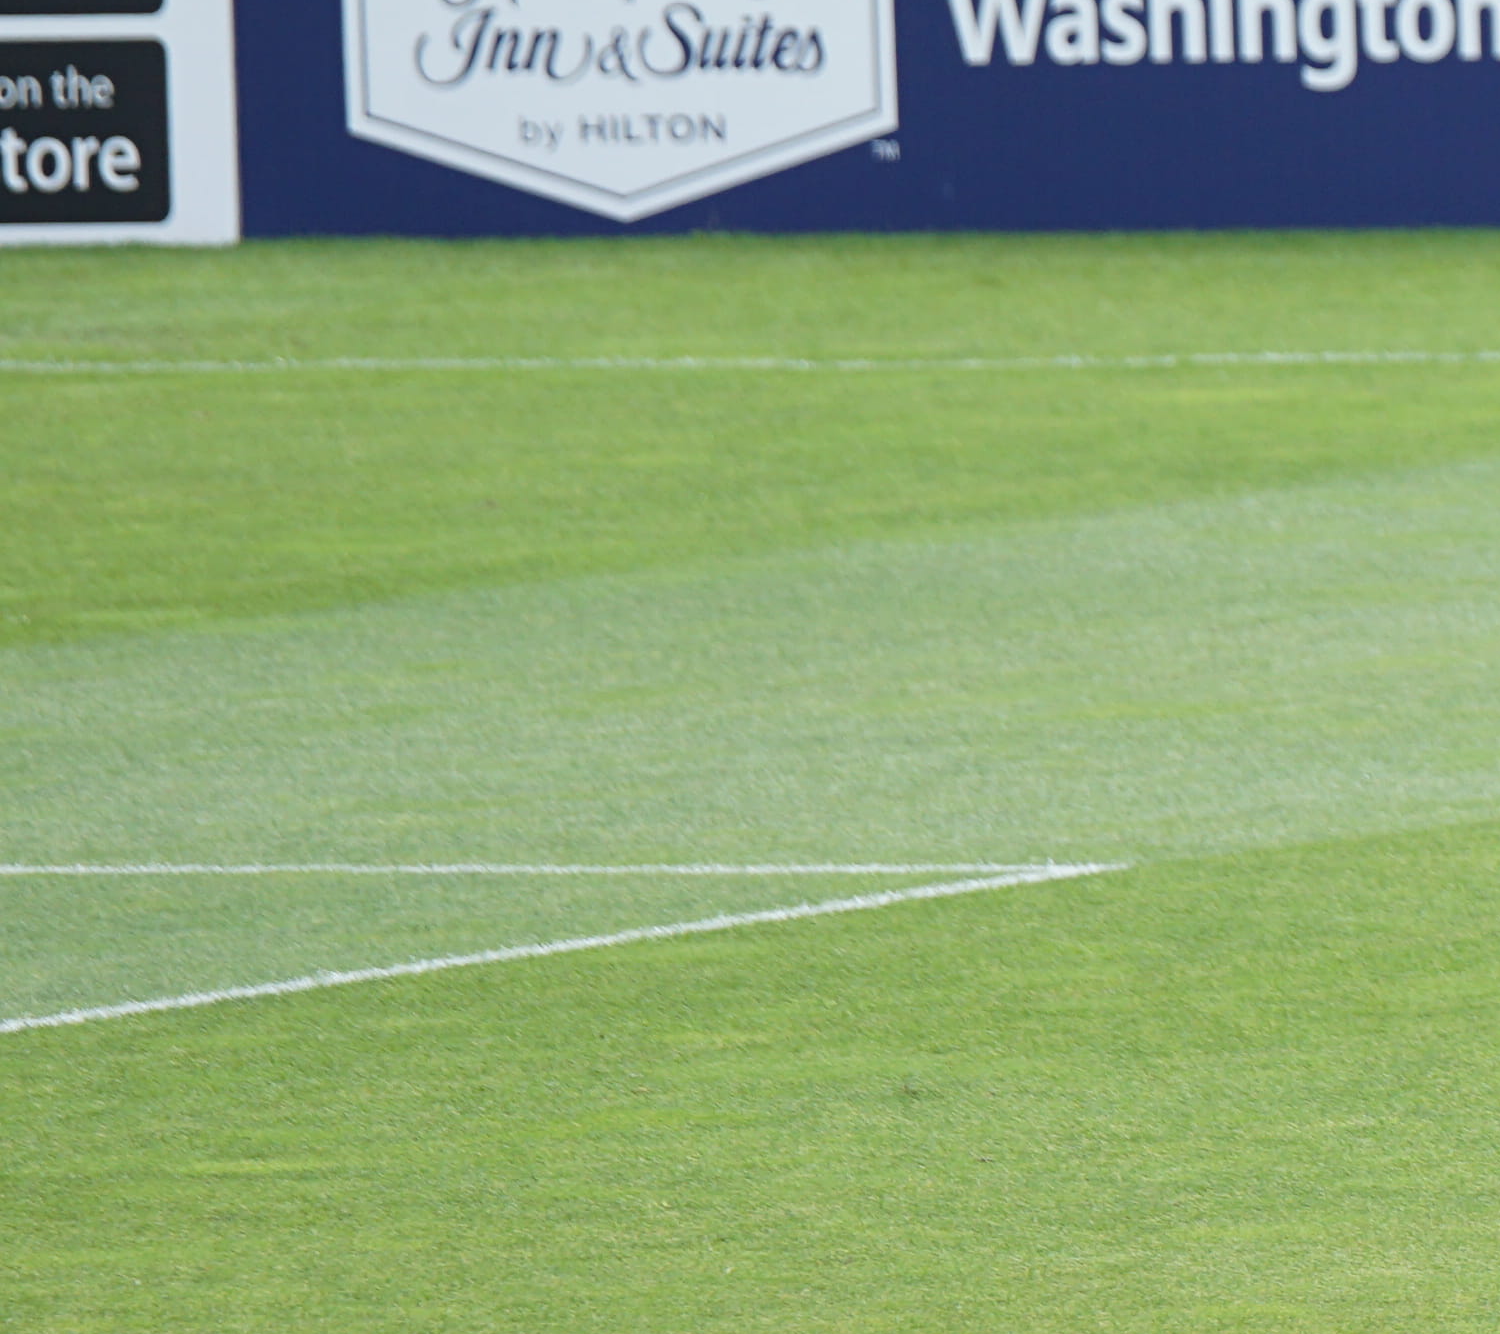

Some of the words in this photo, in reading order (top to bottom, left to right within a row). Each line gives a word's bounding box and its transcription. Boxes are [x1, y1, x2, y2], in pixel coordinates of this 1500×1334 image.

[415, 8, 593, 86] Inn
[599, 25, 640, 83] &
[639, 2, 826, 77] Suites
[50, 64, 115, 109] the
[518, 116, 563, 150] by
[577, 112, 729, 144] HILTON
